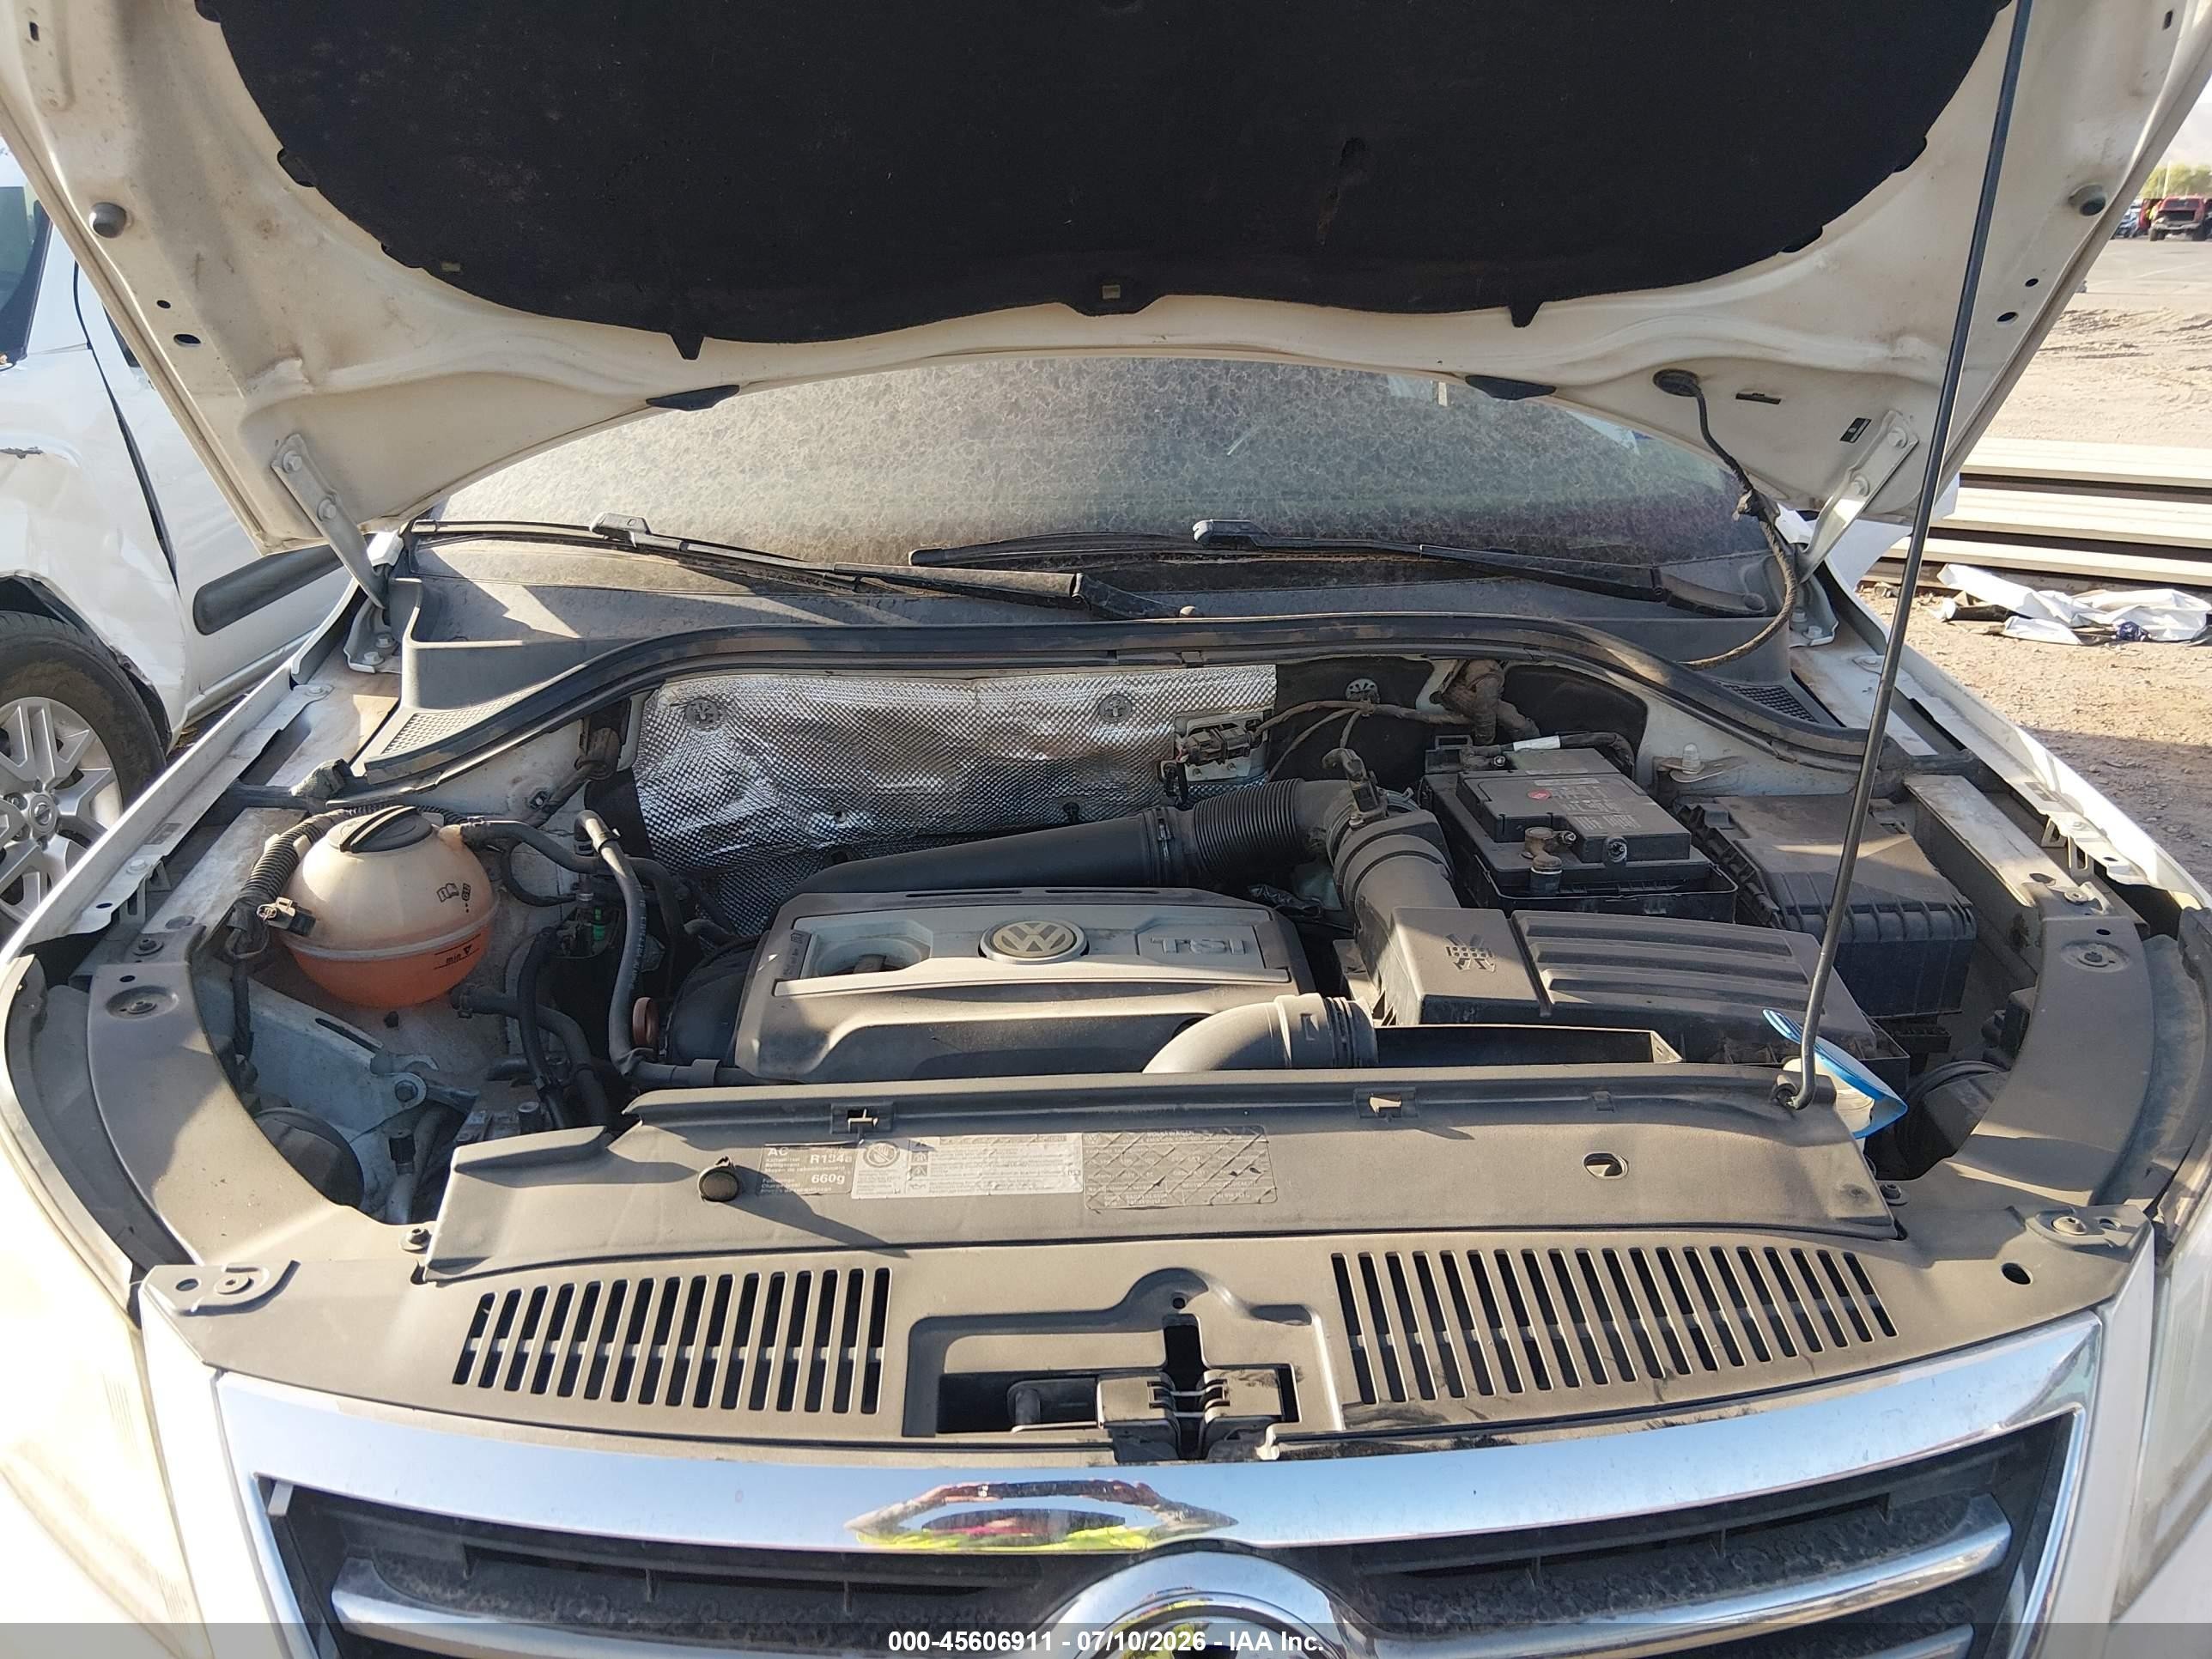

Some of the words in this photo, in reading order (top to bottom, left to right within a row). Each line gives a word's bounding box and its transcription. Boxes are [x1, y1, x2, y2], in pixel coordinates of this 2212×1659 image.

[1151, 935, 1246, 955] TSI
[446, 953, 461, 963] min
[768, 1146, 789, 1157] AC
[811, 1173, 846, 1185] 660g
